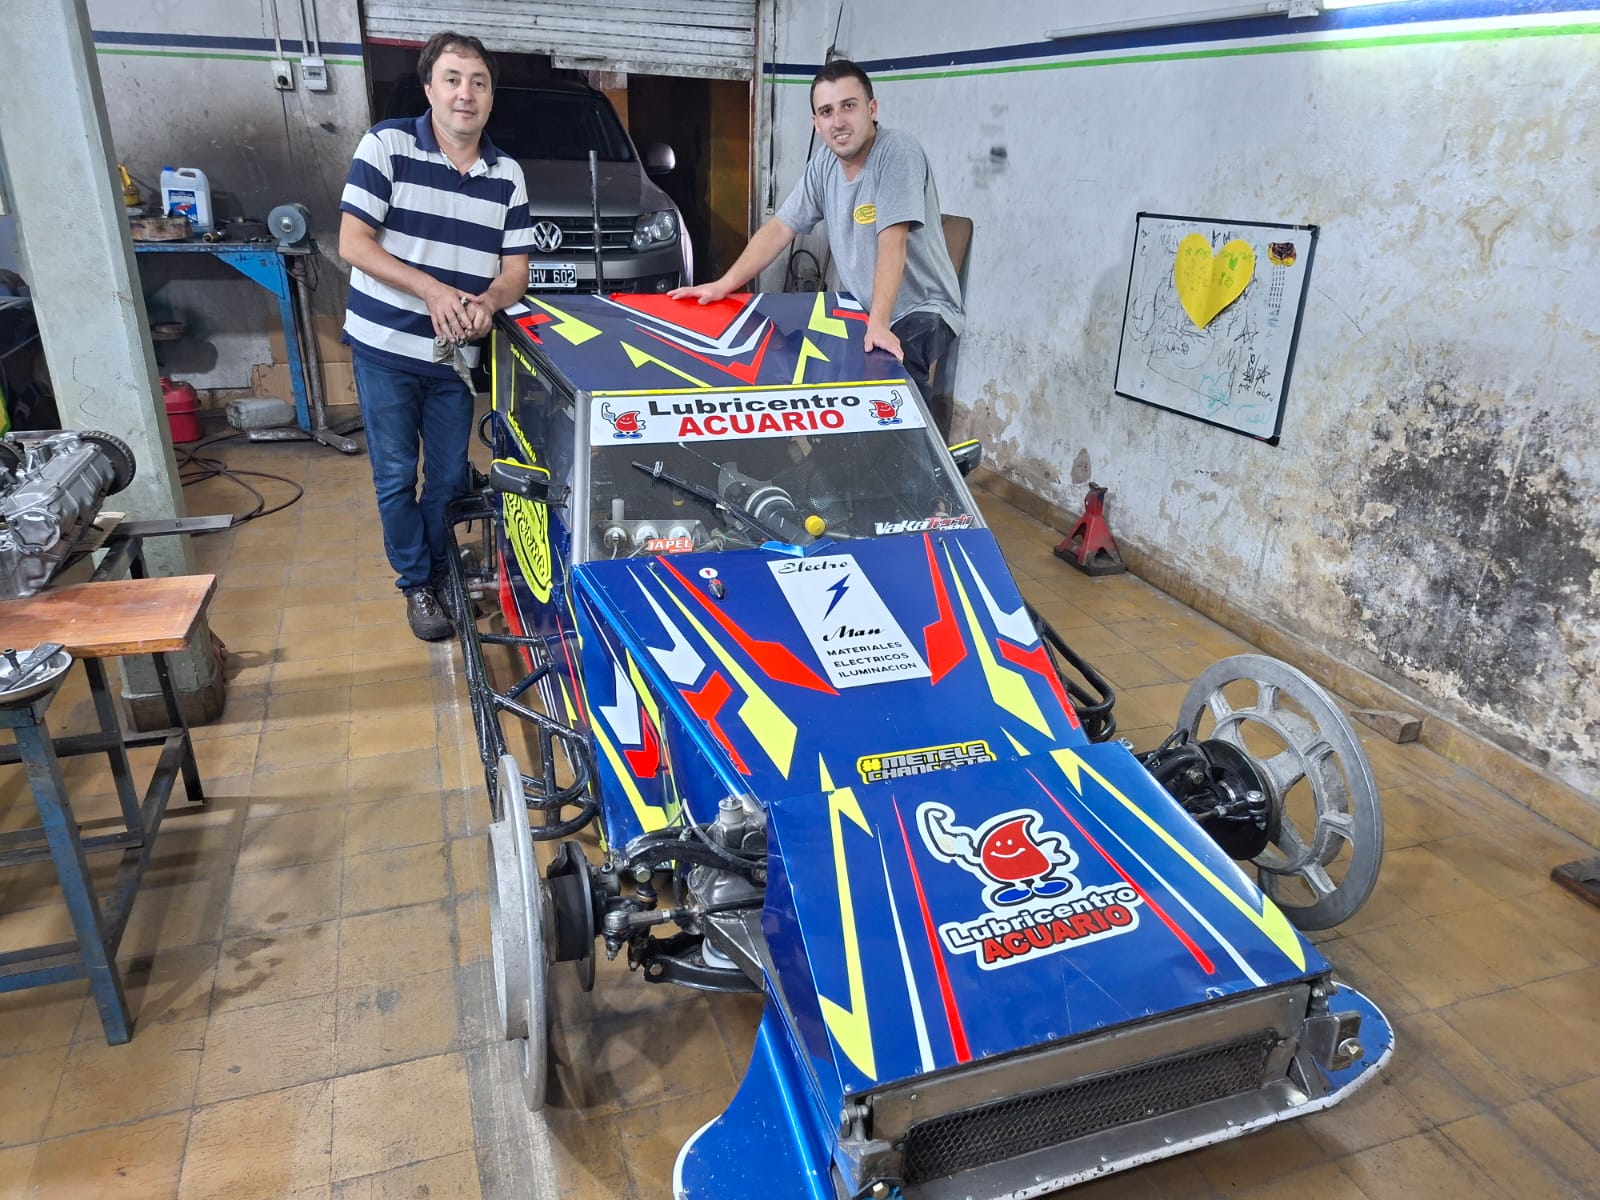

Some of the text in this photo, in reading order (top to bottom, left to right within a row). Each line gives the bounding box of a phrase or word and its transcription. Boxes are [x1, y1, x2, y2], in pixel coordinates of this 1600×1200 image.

[553, 269, 574, 283] 602
[648, 393, 860, 416] Lubricentro
[678, 409, 844, 437] ACUARIO
[778, 561, 848, 574] Electro
[823, 625, 883, 642] Man
[826, 641, 902, 656] MATERIALES
[833, 653, 909, 668] ELECTRICOS
[838, 662, 917, 678] ILUMINACION
[861, 744, 985, 772] #METELE
[946, 886, 1139, 948] Lubricentro
[982, 903, 1133, 964] ACUARIO
